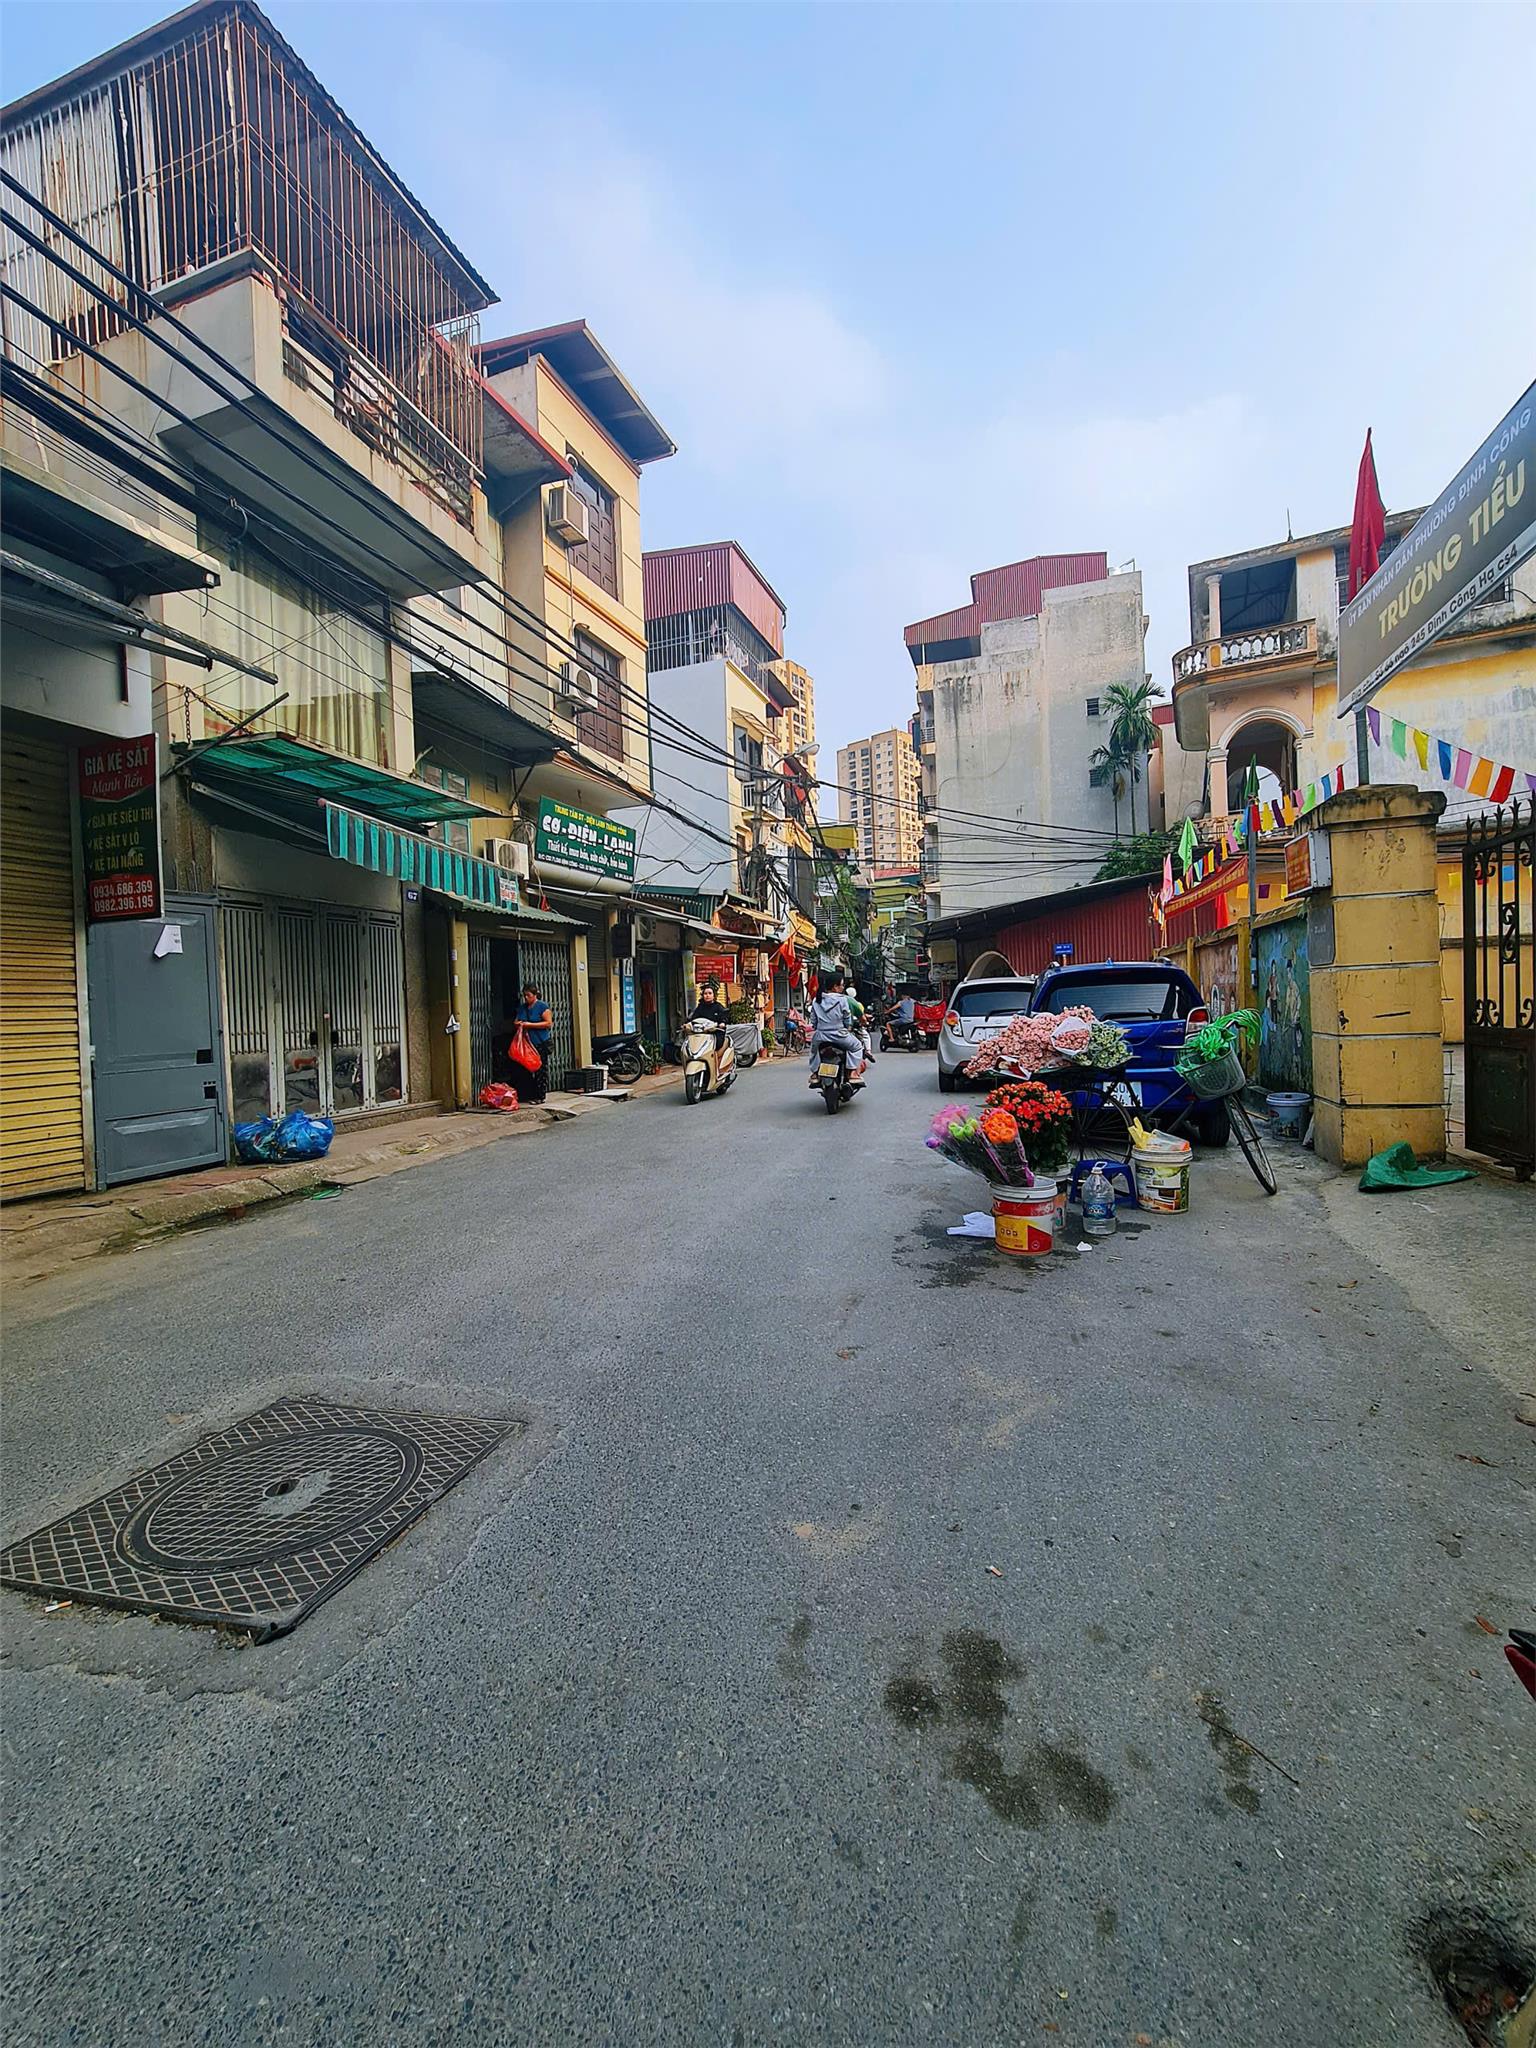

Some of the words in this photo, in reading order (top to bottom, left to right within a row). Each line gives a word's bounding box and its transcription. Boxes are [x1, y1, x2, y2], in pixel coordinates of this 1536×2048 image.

[1358, 594, 1372, 617] BAN
[1373, 568, 1394, 600] NHÂN
[1396, 544, 1413, 575] DÂN
[1458, 458, 1487, 502] ĐỊNH
[1490, 408, 1531, 463] CÔNG
[1379, 533, 1462, 639] TRƯỜNG
[1468, 459, 1526, 546] TIỂU
[1410, 629, 1426, 649] 245
[1427, 611, 1448, 634] Định
[1449, 584, 1477, 614] Công
[1478, 568, 1495, 587] Hạ
[1497, 544, 1518, 571] cs4
[107, 748, 122, 774] KỆ
[126, 741, 149, 768] SẮT
[92, 777, 120, 796] Mạnh
[120, 808, 139, 824] SIÊU
[140, 806, 154, 822] THỊ
[105, 830, 120, 849] SẮT
[542, 815, 561, 834] CƠ
[568, 822, 597, 847] ĐIỆN
[603, 834, 633, 857] LẠNH
[547, 839, 560, 852] Thiết
[93, 880, 153, 898] 0934.686.369
[408, 891, 418, 900] 67
[94, 895, 154, 912] 0982.396.195
